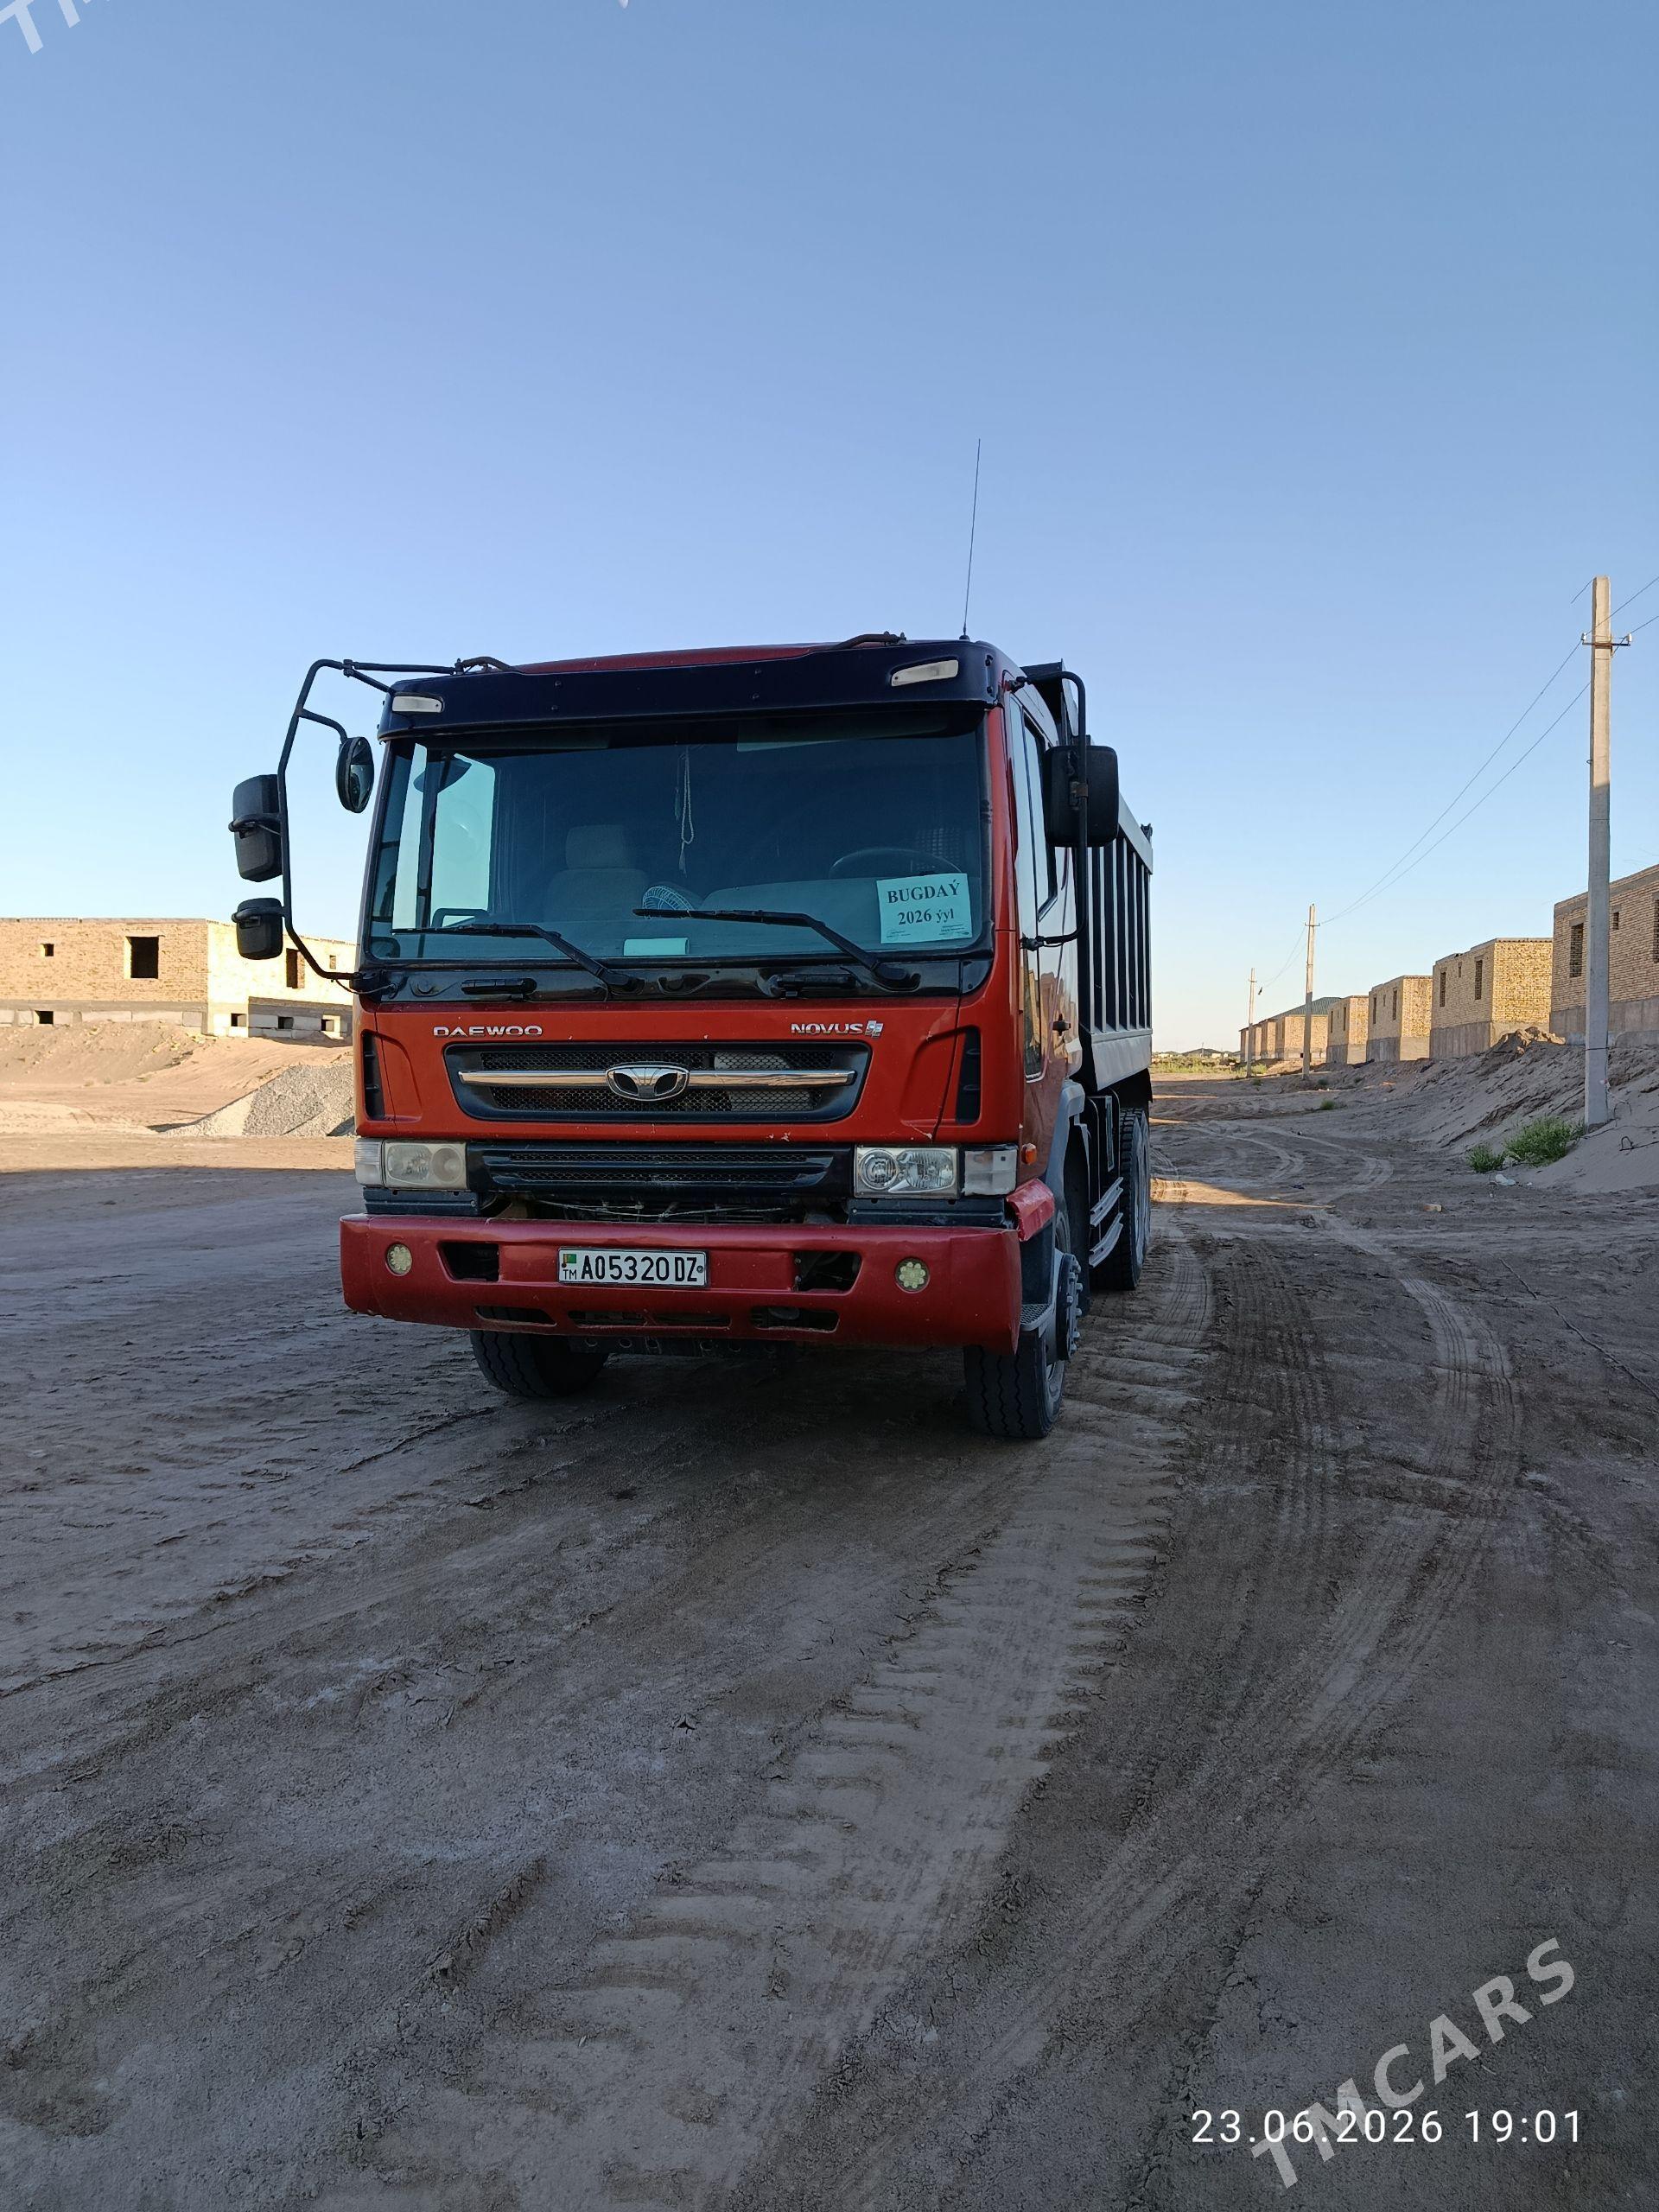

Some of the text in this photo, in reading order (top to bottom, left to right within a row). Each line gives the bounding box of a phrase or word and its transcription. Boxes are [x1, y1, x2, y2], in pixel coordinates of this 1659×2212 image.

[887, 880, 960, 904] BUGDAÝ
[898, 909, 932, 925] 2026
[433, 1025, 543, 1037] DAEWOO
[791, 1023, 863, 1034] NOVUS
[563, 1269, 577, 1281] TM
